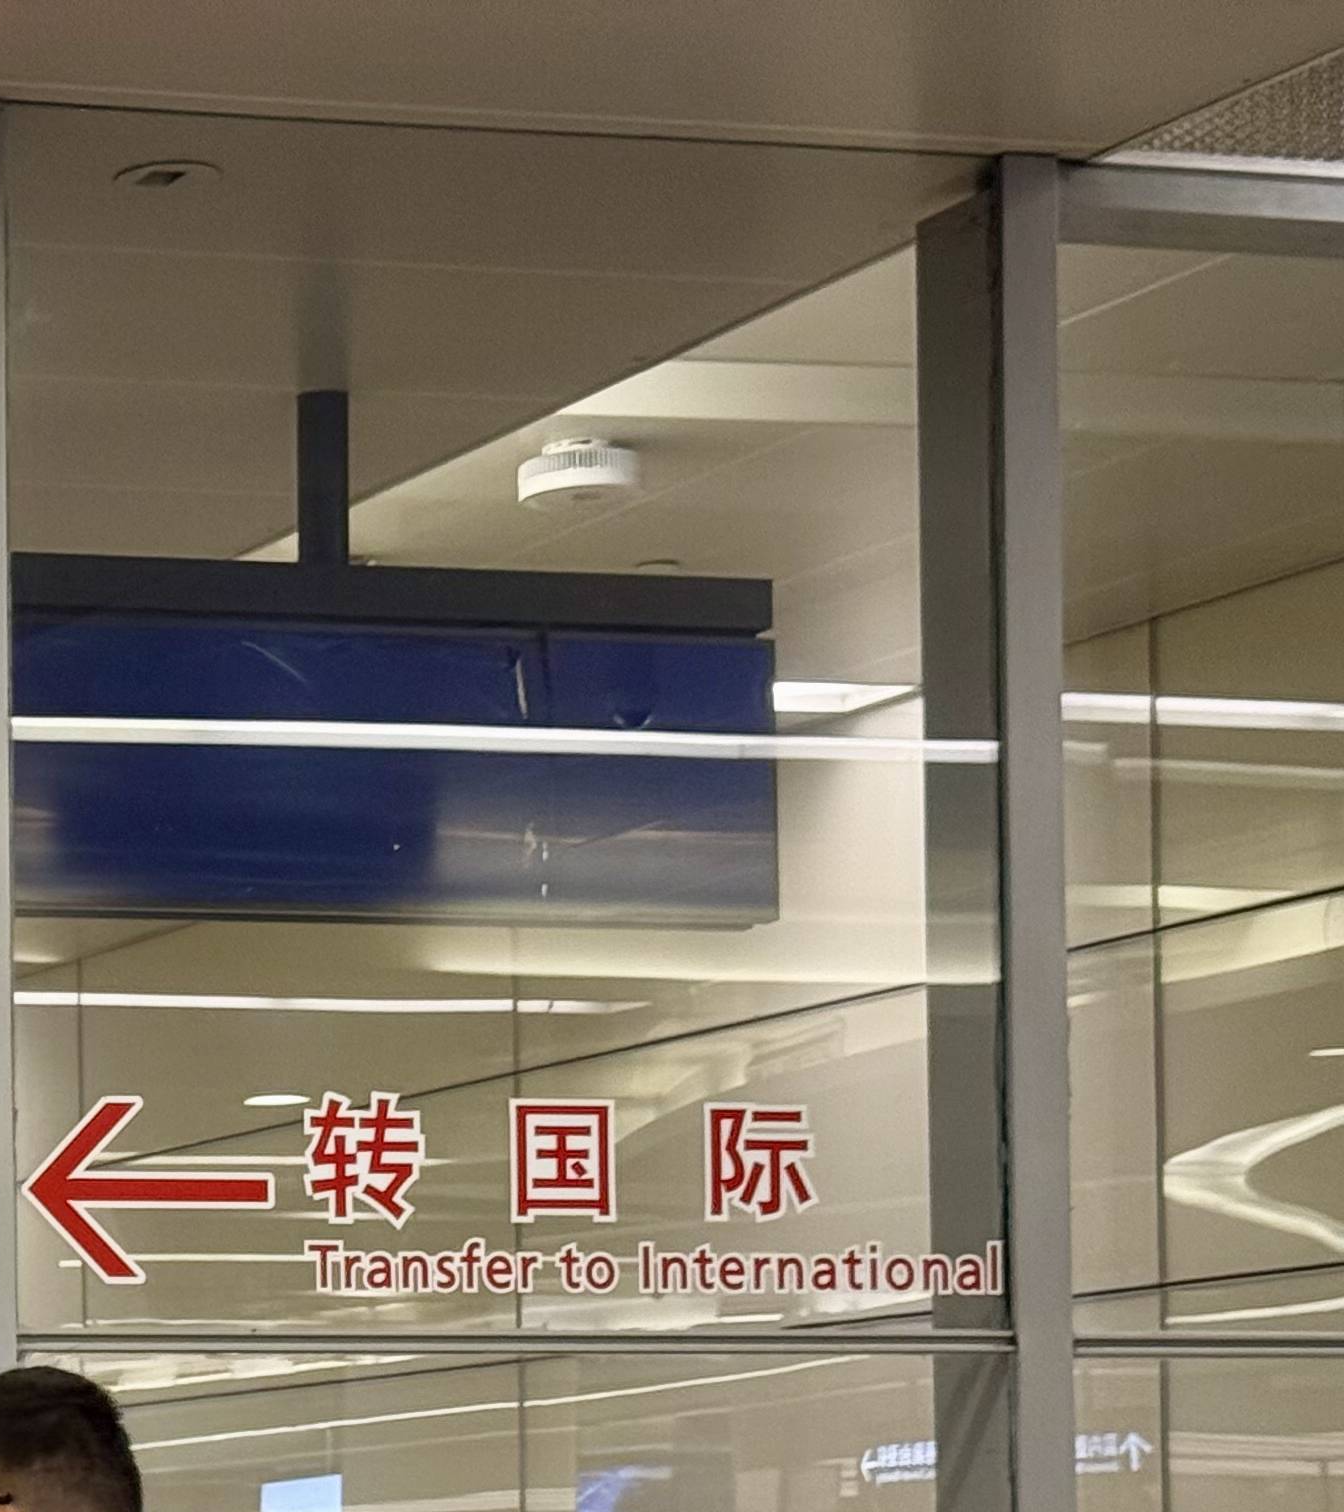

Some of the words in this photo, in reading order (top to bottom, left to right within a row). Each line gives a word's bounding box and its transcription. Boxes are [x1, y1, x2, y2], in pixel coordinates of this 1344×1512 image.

[308, 1241, 539, 1293] Transfer
[556, 1243, 618, 1293] to
[639, 1241, 1004, 1294] International
